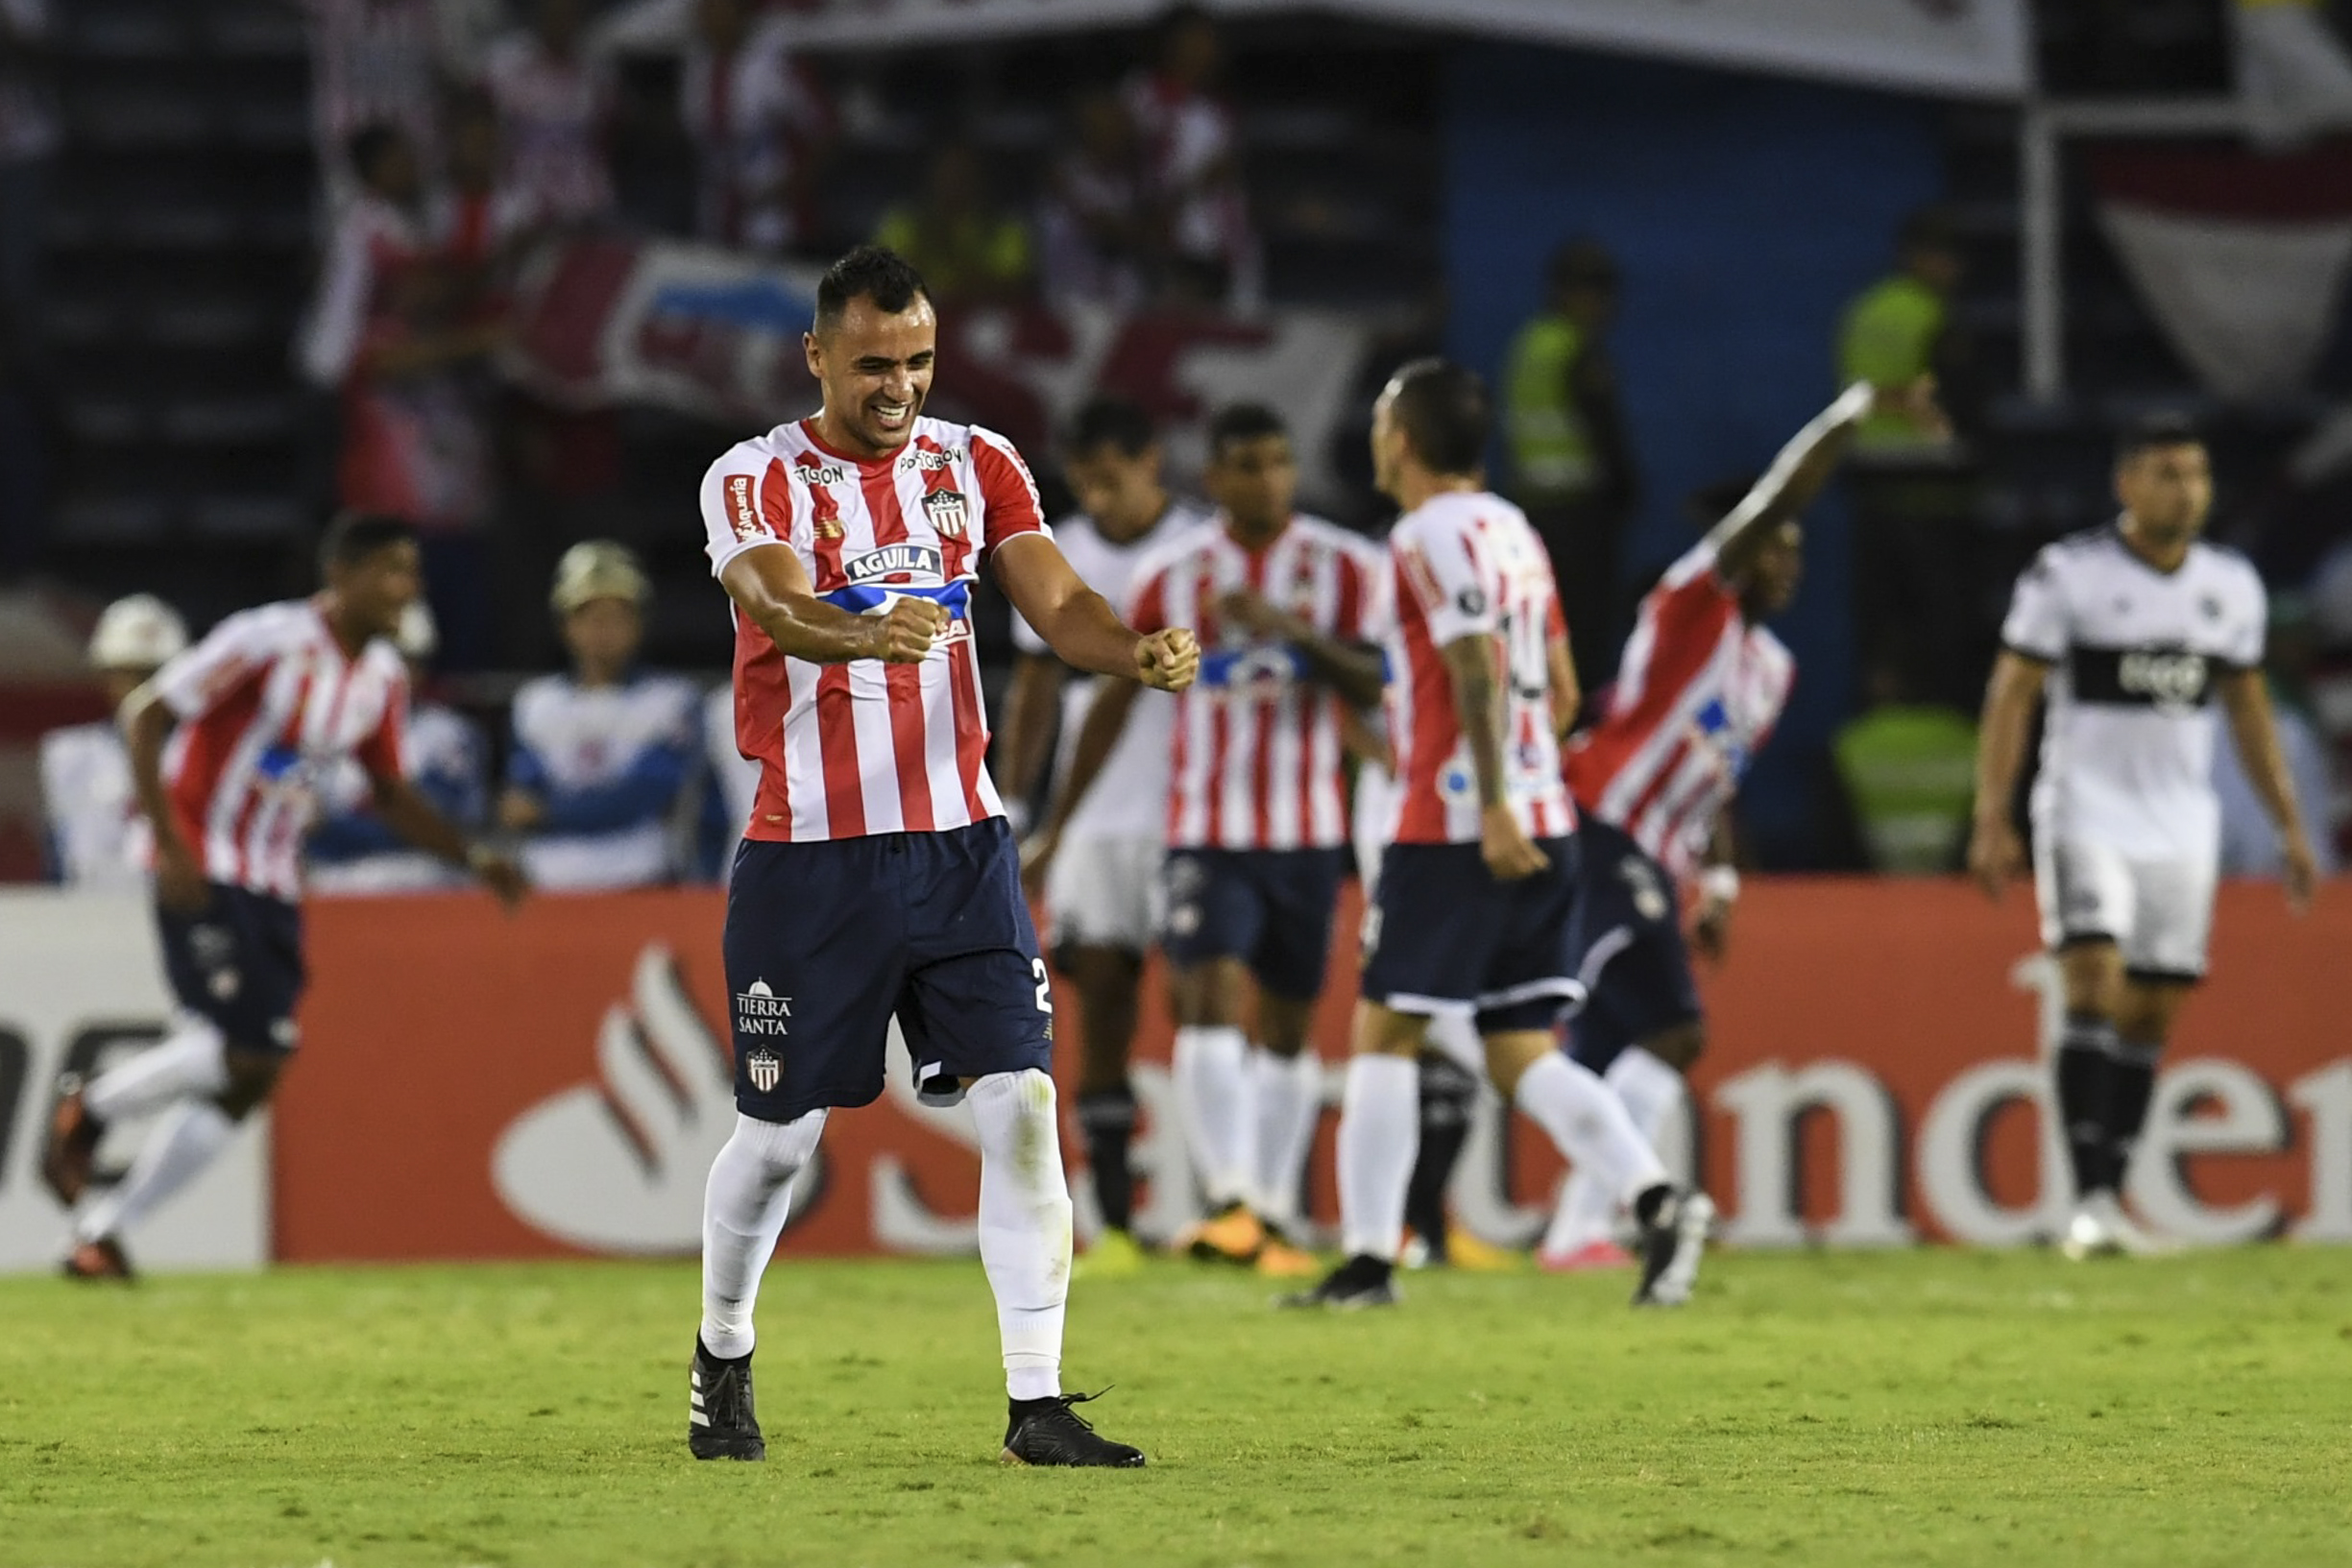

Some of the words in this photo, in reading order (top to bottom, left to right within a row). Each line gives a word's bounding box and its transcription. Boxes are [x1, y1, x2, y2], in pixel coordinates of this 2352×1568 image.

[932, 504, 960, 513] JUNIOR
[853, 546, 933, 578] AGUILA
[1031, 957, 1054, 1014] 2
[737, 997, 792, 1017] TIERRA
[739, 1016, 788, 1035] SANTA
